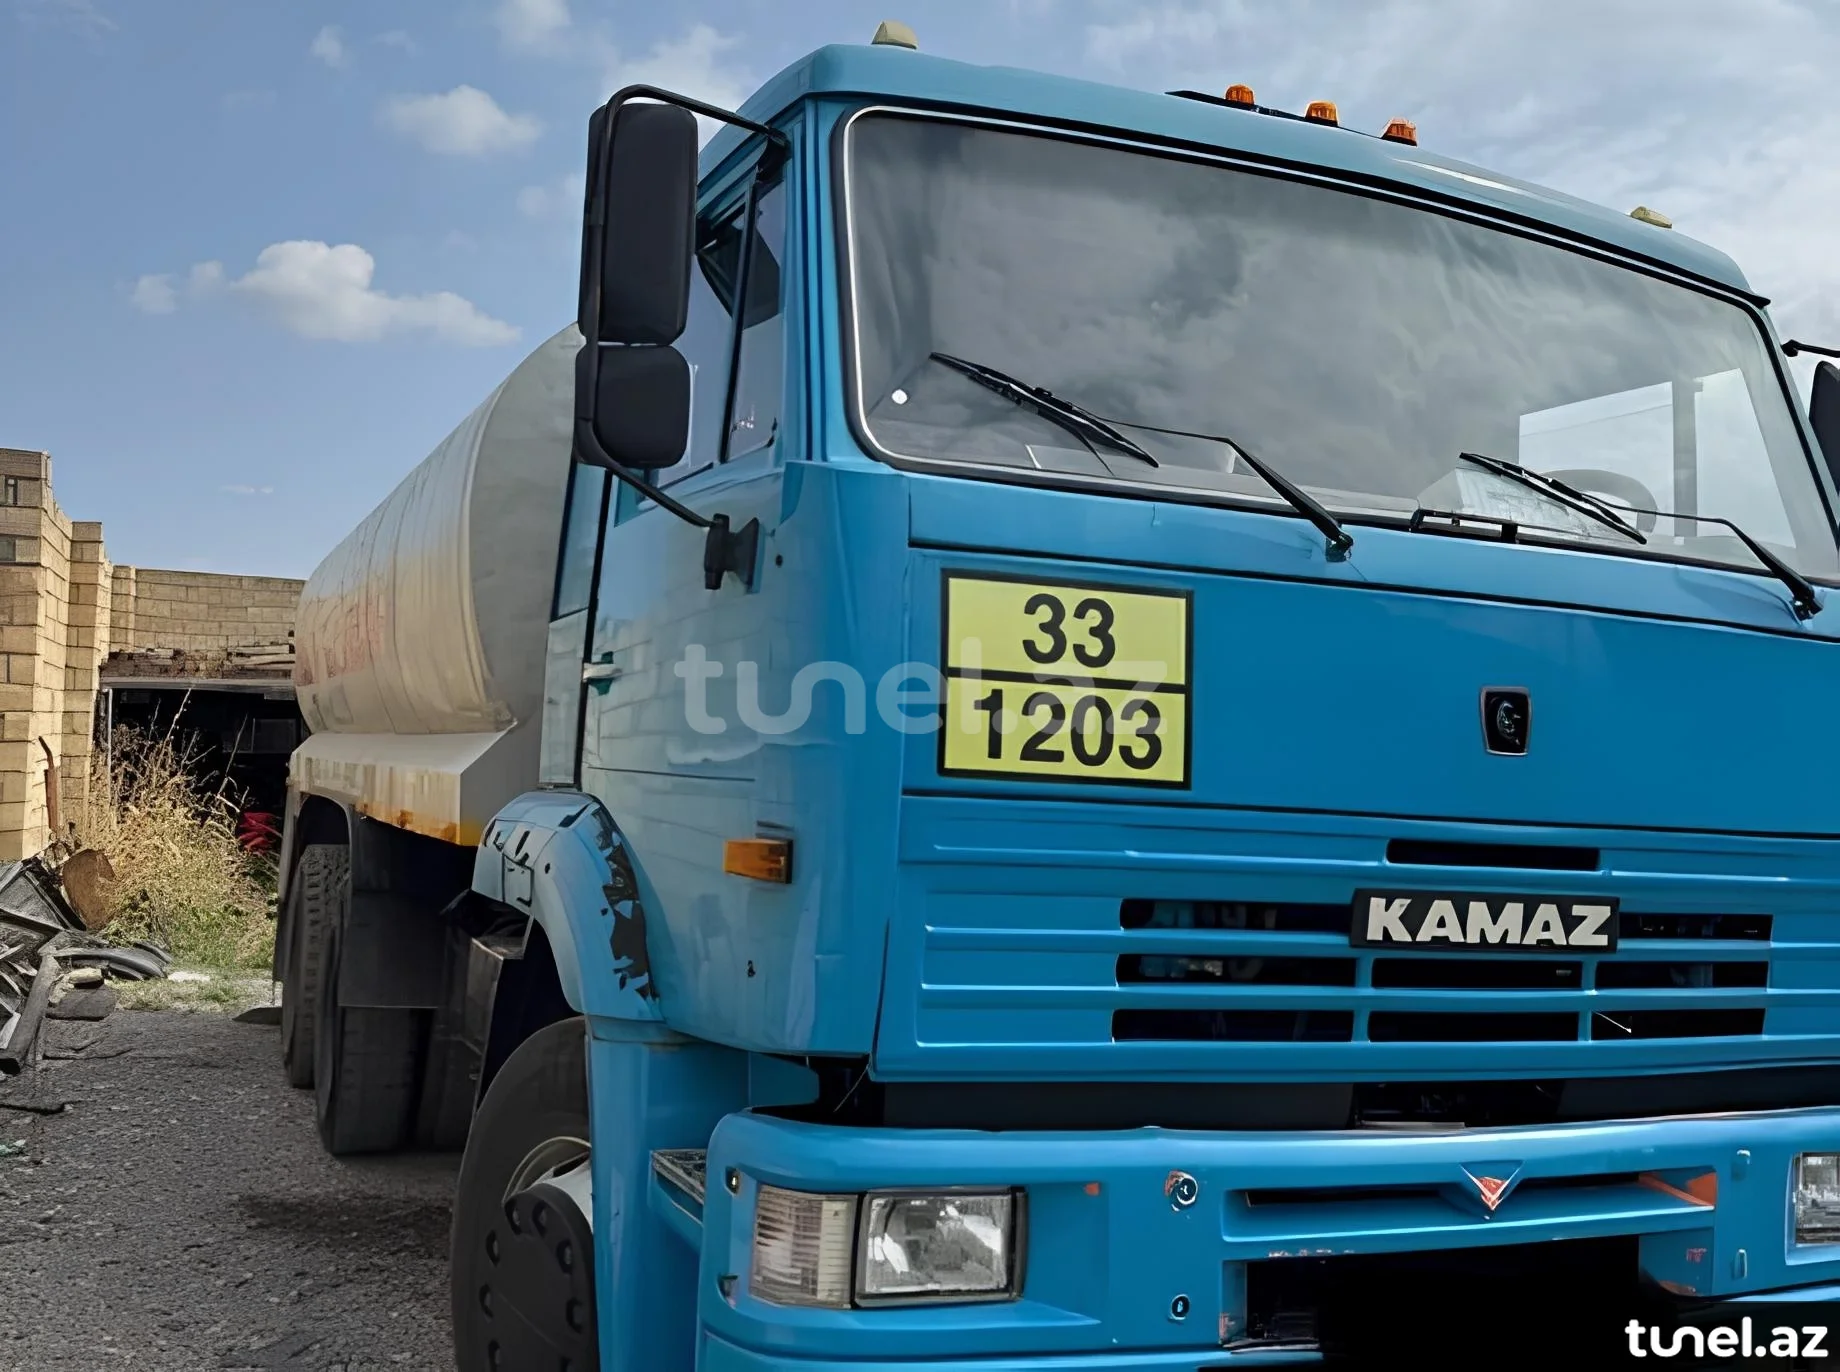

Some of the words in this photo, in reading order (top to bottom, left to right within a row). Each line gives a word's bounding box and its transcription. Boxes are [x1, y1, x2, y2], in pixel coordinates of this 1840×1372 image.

[1022, 593, 1116, 668] 33
[974, 688, 1162, 769] 1203
[1366, 897, 1612, 946] KAMAZ
